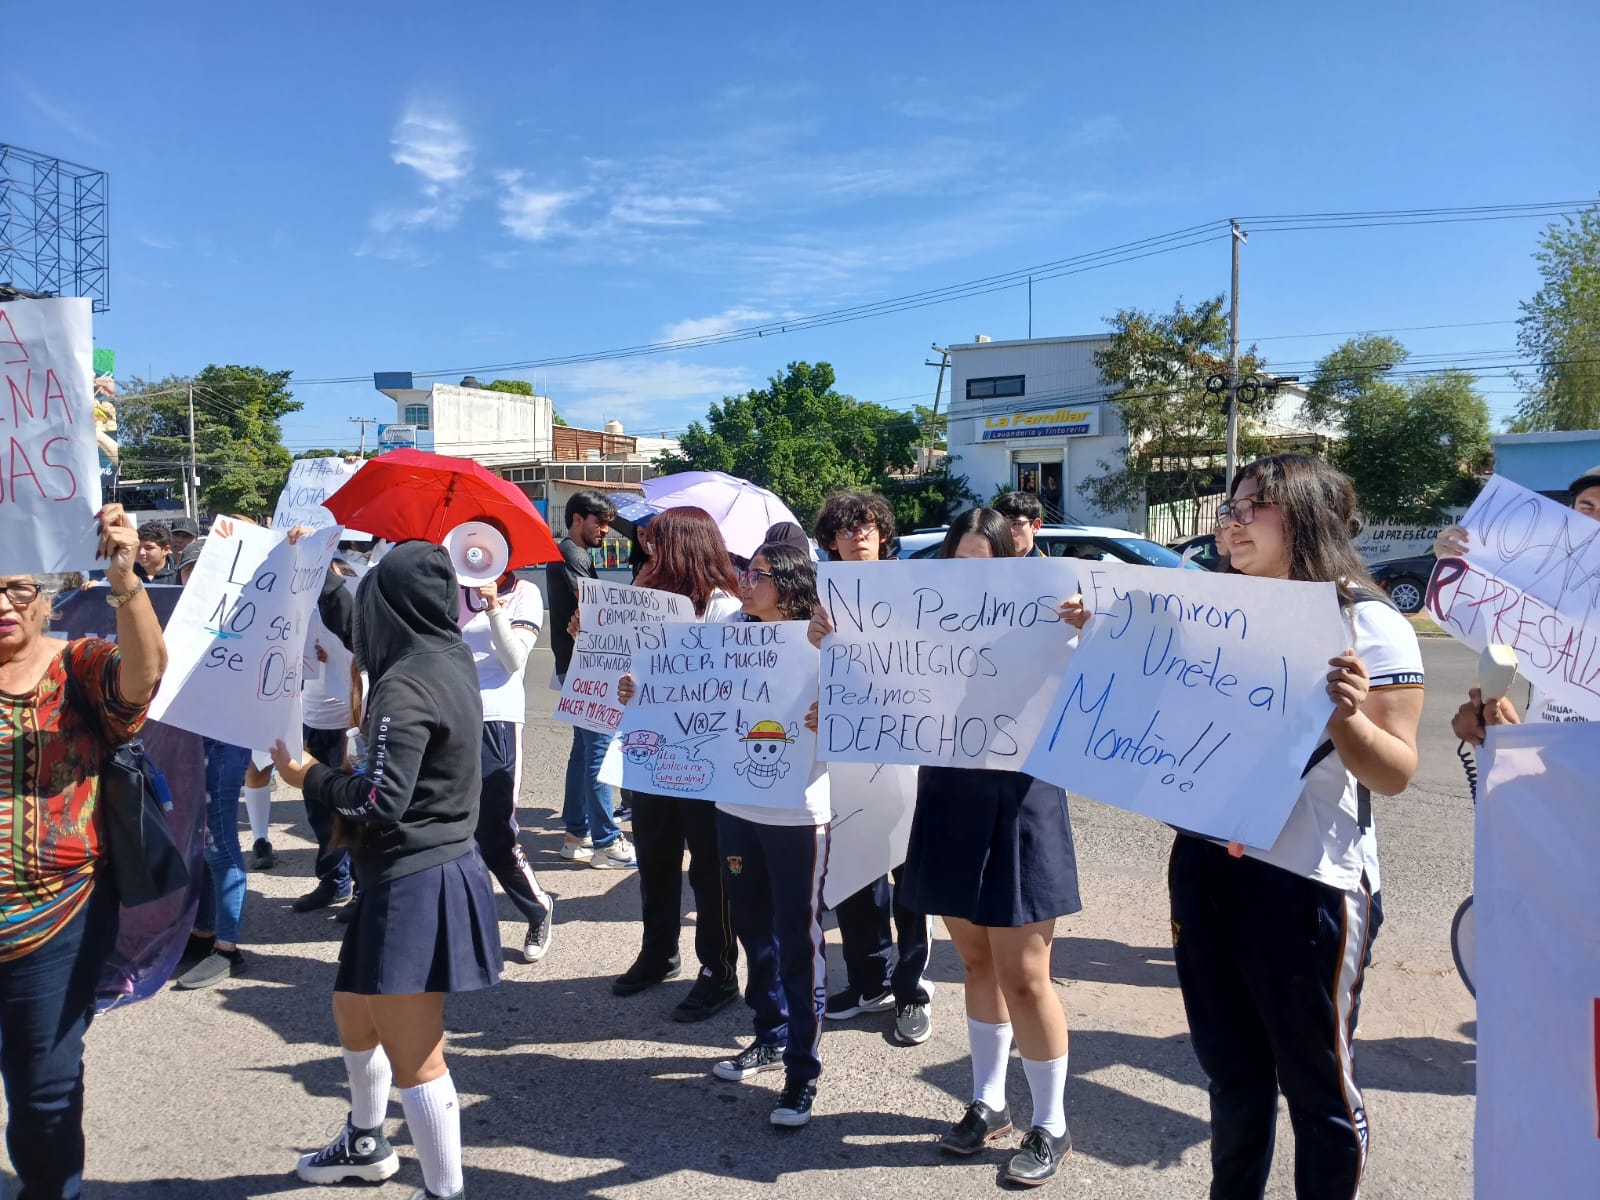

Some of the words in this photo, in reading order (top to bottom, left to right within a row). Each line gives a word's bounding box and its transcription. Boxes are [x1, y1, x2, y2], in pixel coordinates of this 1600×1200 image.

[984, 415, 1010, 429] La
[1012, 408, 1091, 426] Familiar
[1373, 530, 1384, 540] LA
[1385, 530, 1401, 540] PAZ
[1463, 485, 1541, 563] NO
[209, 593, 256, 633] NO
[667, 597, 679, 616] NI
[827, 578, 892, 633] No
[913, 587, 1061, 632] Pedimos
[681, 625, 708, 650] SE
[721, 623, 785, 648] PUEDE
[1425, 557, 1600, 697] REPRESALI
[650, 652, 714, 675] HACER
[827, 639, 998, 677] PRIVILEGIOS
[572, 677, 609, 698] QUIERO
[742, 679, 770, 703] LA
[1248, 655, 1289, 716] al
[1398, 674, 1423, 684] UAS
[558, 697, 583, 716] HACER
[825, 682, 931, 706] Pedimos
[825, 714, 1018, 758] DERECHOS
[372, 716, 391, 786] SOUTHERN
